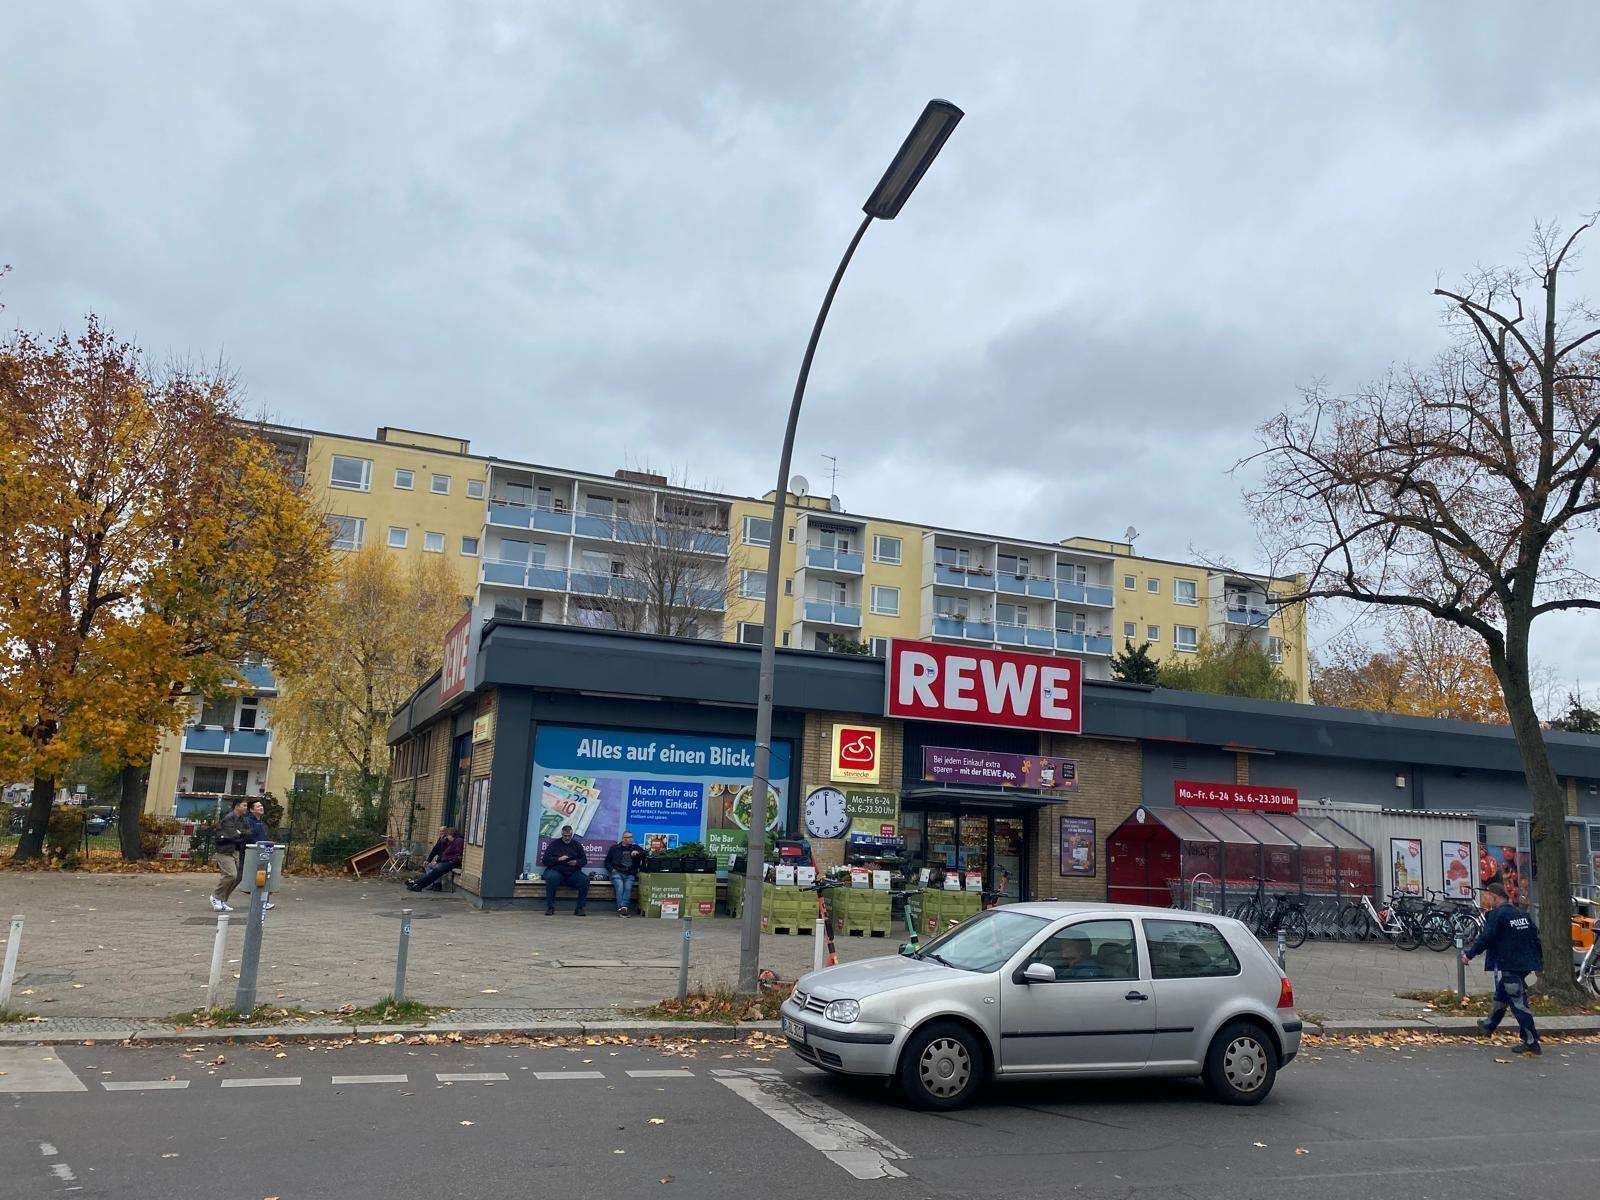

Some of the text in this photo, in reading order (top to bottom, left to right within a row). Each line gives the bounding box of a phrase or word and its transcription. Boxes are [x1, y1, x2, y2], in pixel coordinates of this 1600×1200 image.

[898, 650, 1072, 721] REWE
[577, 739, 755, 767] Alles auf einen Blick.
[933, 755, 942, 764] Bei
[944, 756, 961, 766] jedem
[963, 758, 983, 767] Einkauf
[933, 765, 952, 775] sparen
[982, 769, 1001, 778] REWE
[1002, 770, 1016, 779] App.
[633, 785, 656, 796] Mach
[660, 787, 680, 797] mehr
[632, 798, 698, 810] deinem Einkauf.
[1234, 793, 1246, 802] Sa.
[1282, 796, 1294, 804] Uhr
[562, 801, 576, 814] 10
